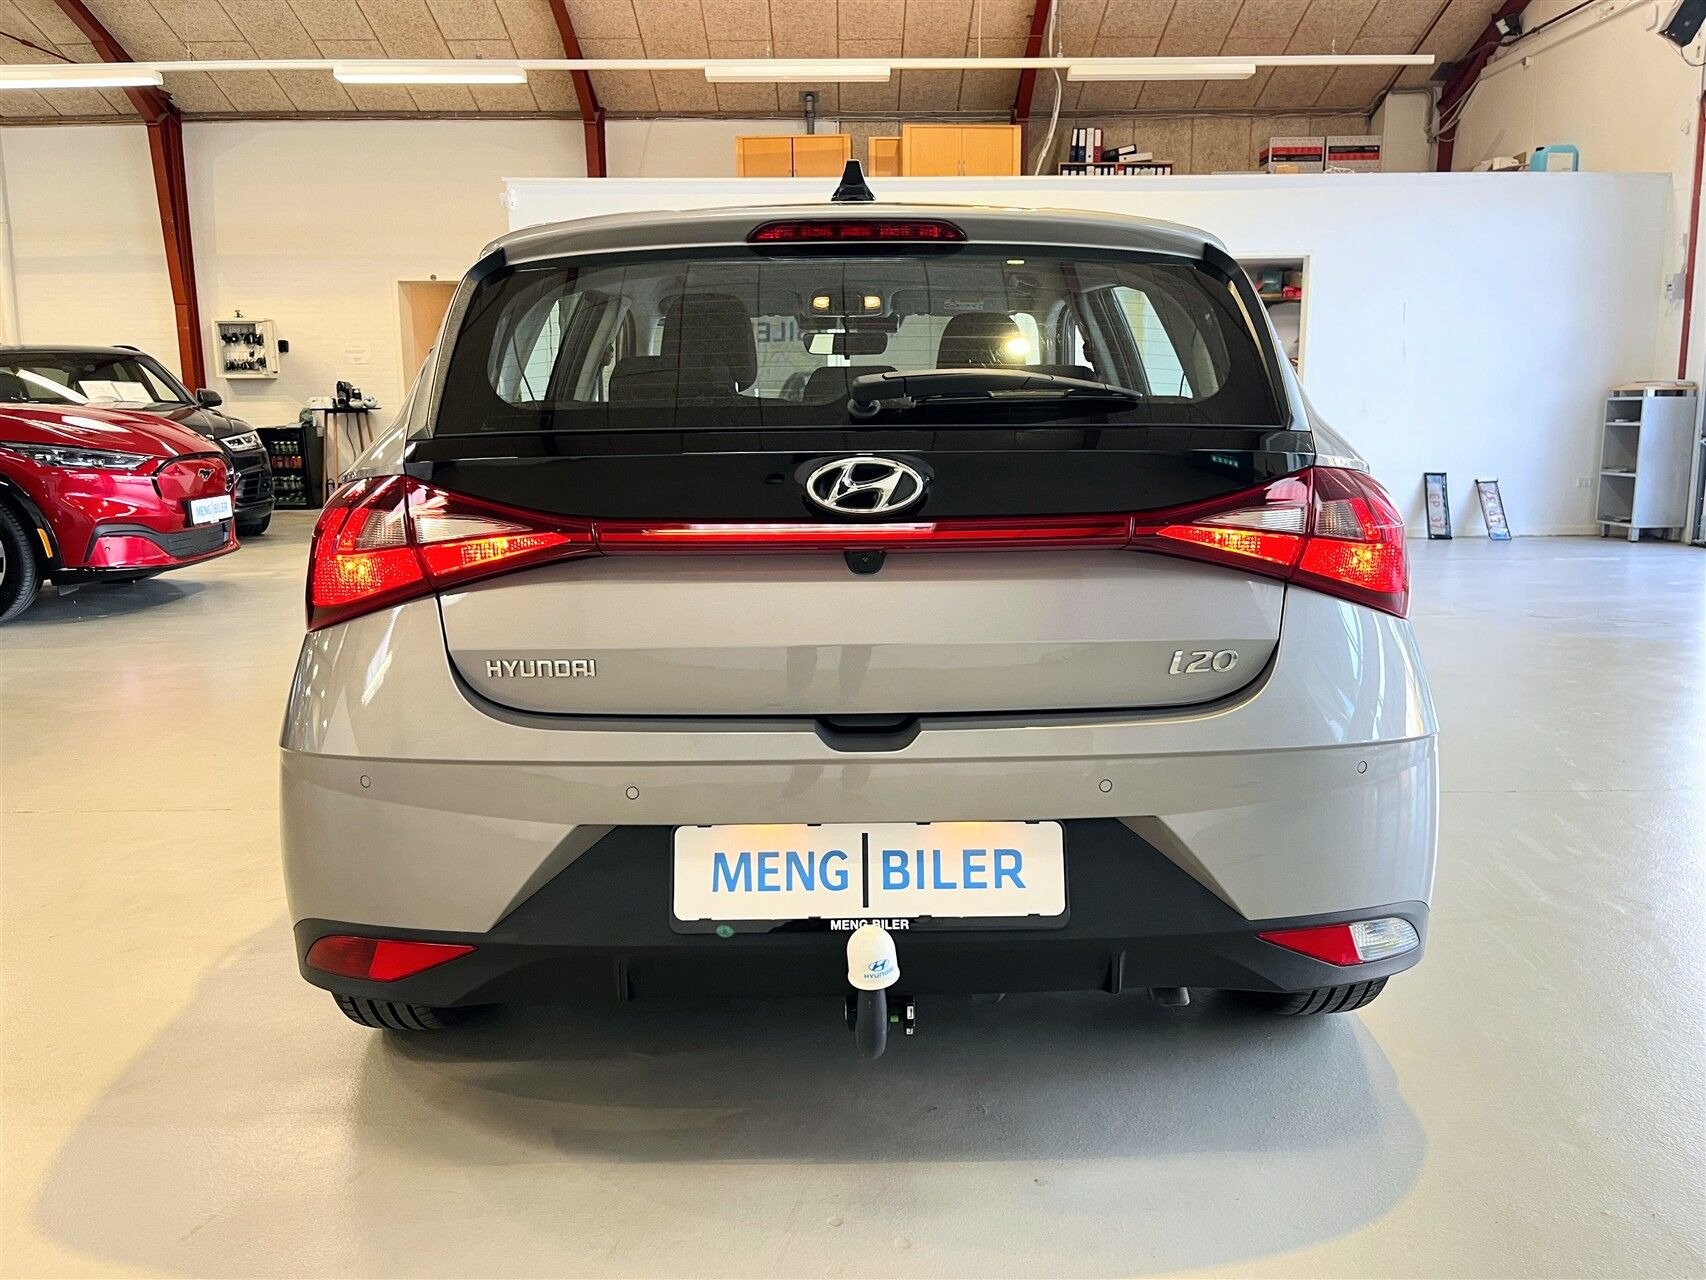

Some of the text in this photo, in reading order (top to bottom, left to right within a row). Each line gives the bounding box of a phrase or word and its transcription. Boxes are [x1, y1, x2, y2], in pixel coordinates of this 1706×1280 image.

[486, 659, 597, 678] HYUNDAI
[1168, 649, 1239, 675] i20
[712, 848, 1027, 893] MENG BILER
